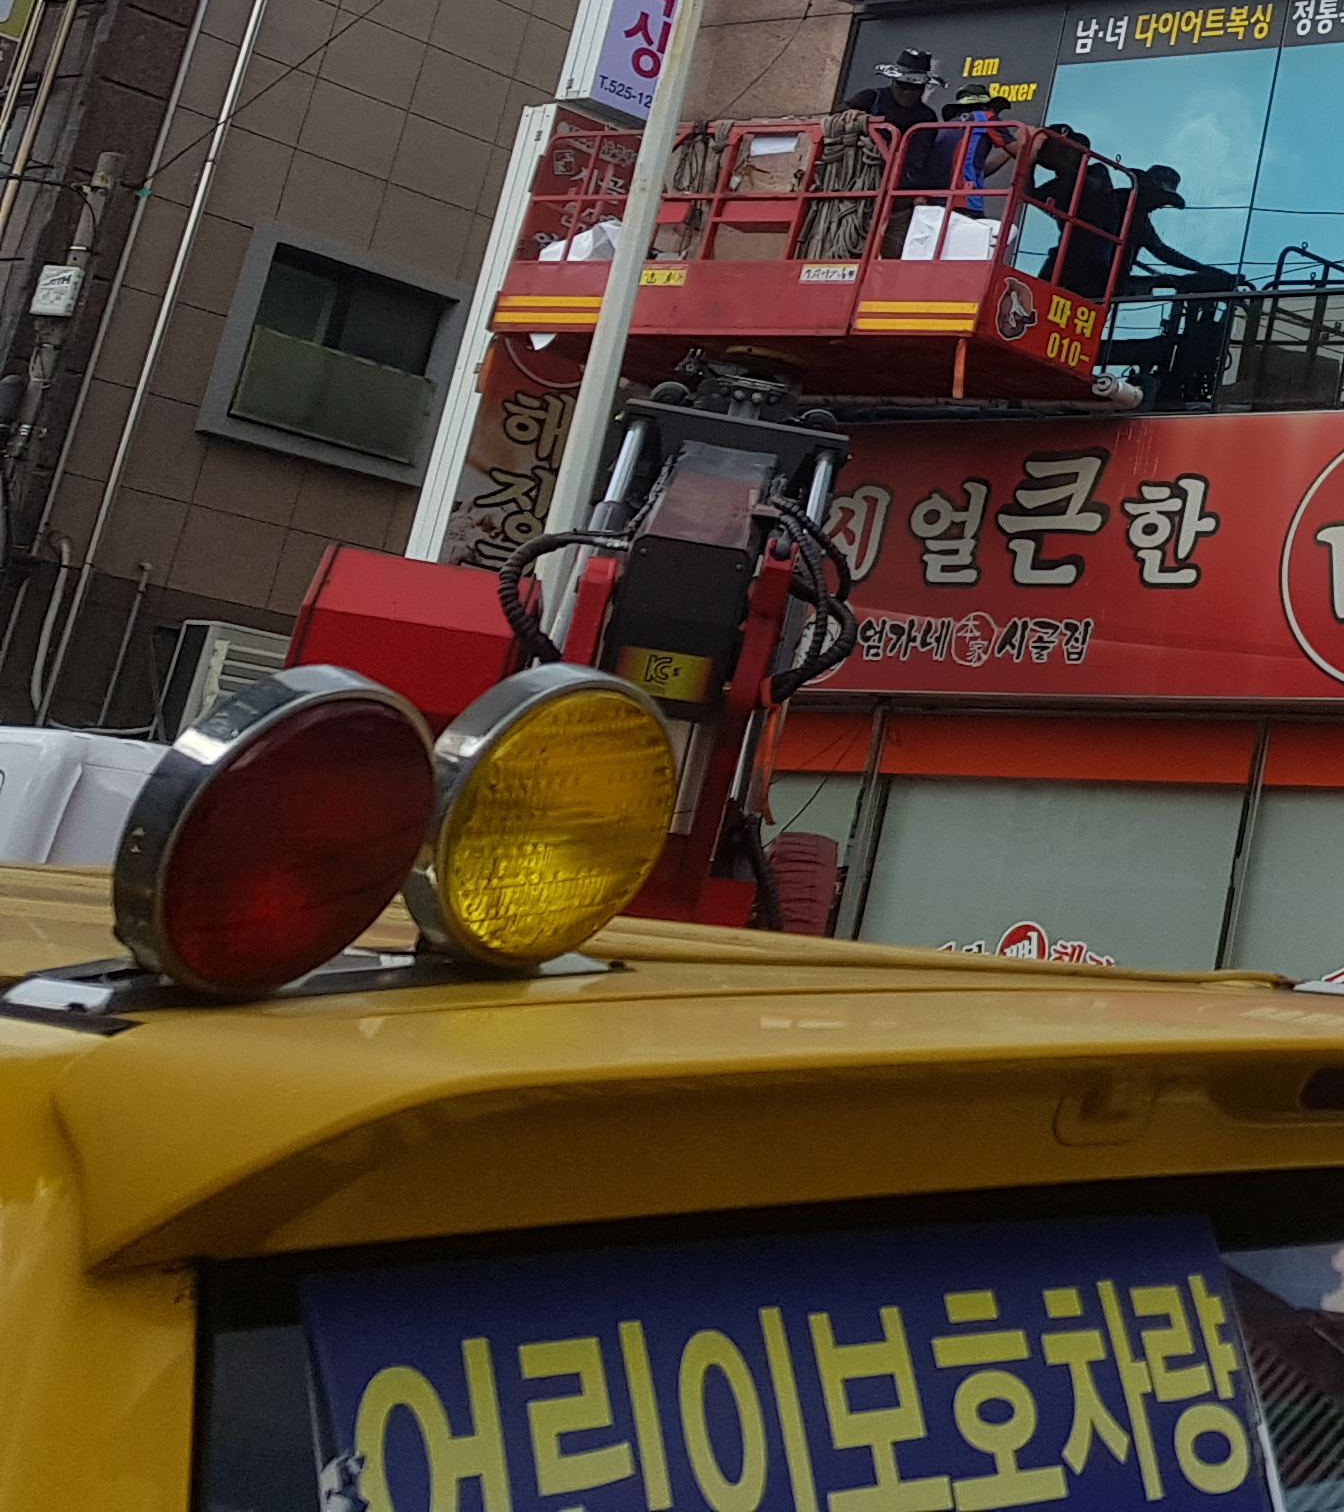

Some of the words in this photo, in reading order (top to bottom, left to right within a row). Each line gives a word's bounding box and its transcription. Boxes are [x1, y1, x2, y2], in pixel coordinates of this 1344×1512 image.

[1132, 3, 1274, 45] 다이어트복싱
[962, 56, 972, 77] I
[972, 57, 1000, 77] am
[1047, 294, 1097, 338] 파워
[994, 617, 1096, 666] 시골집
[349, 1274, 1249, 1512] 어린이보호차량
